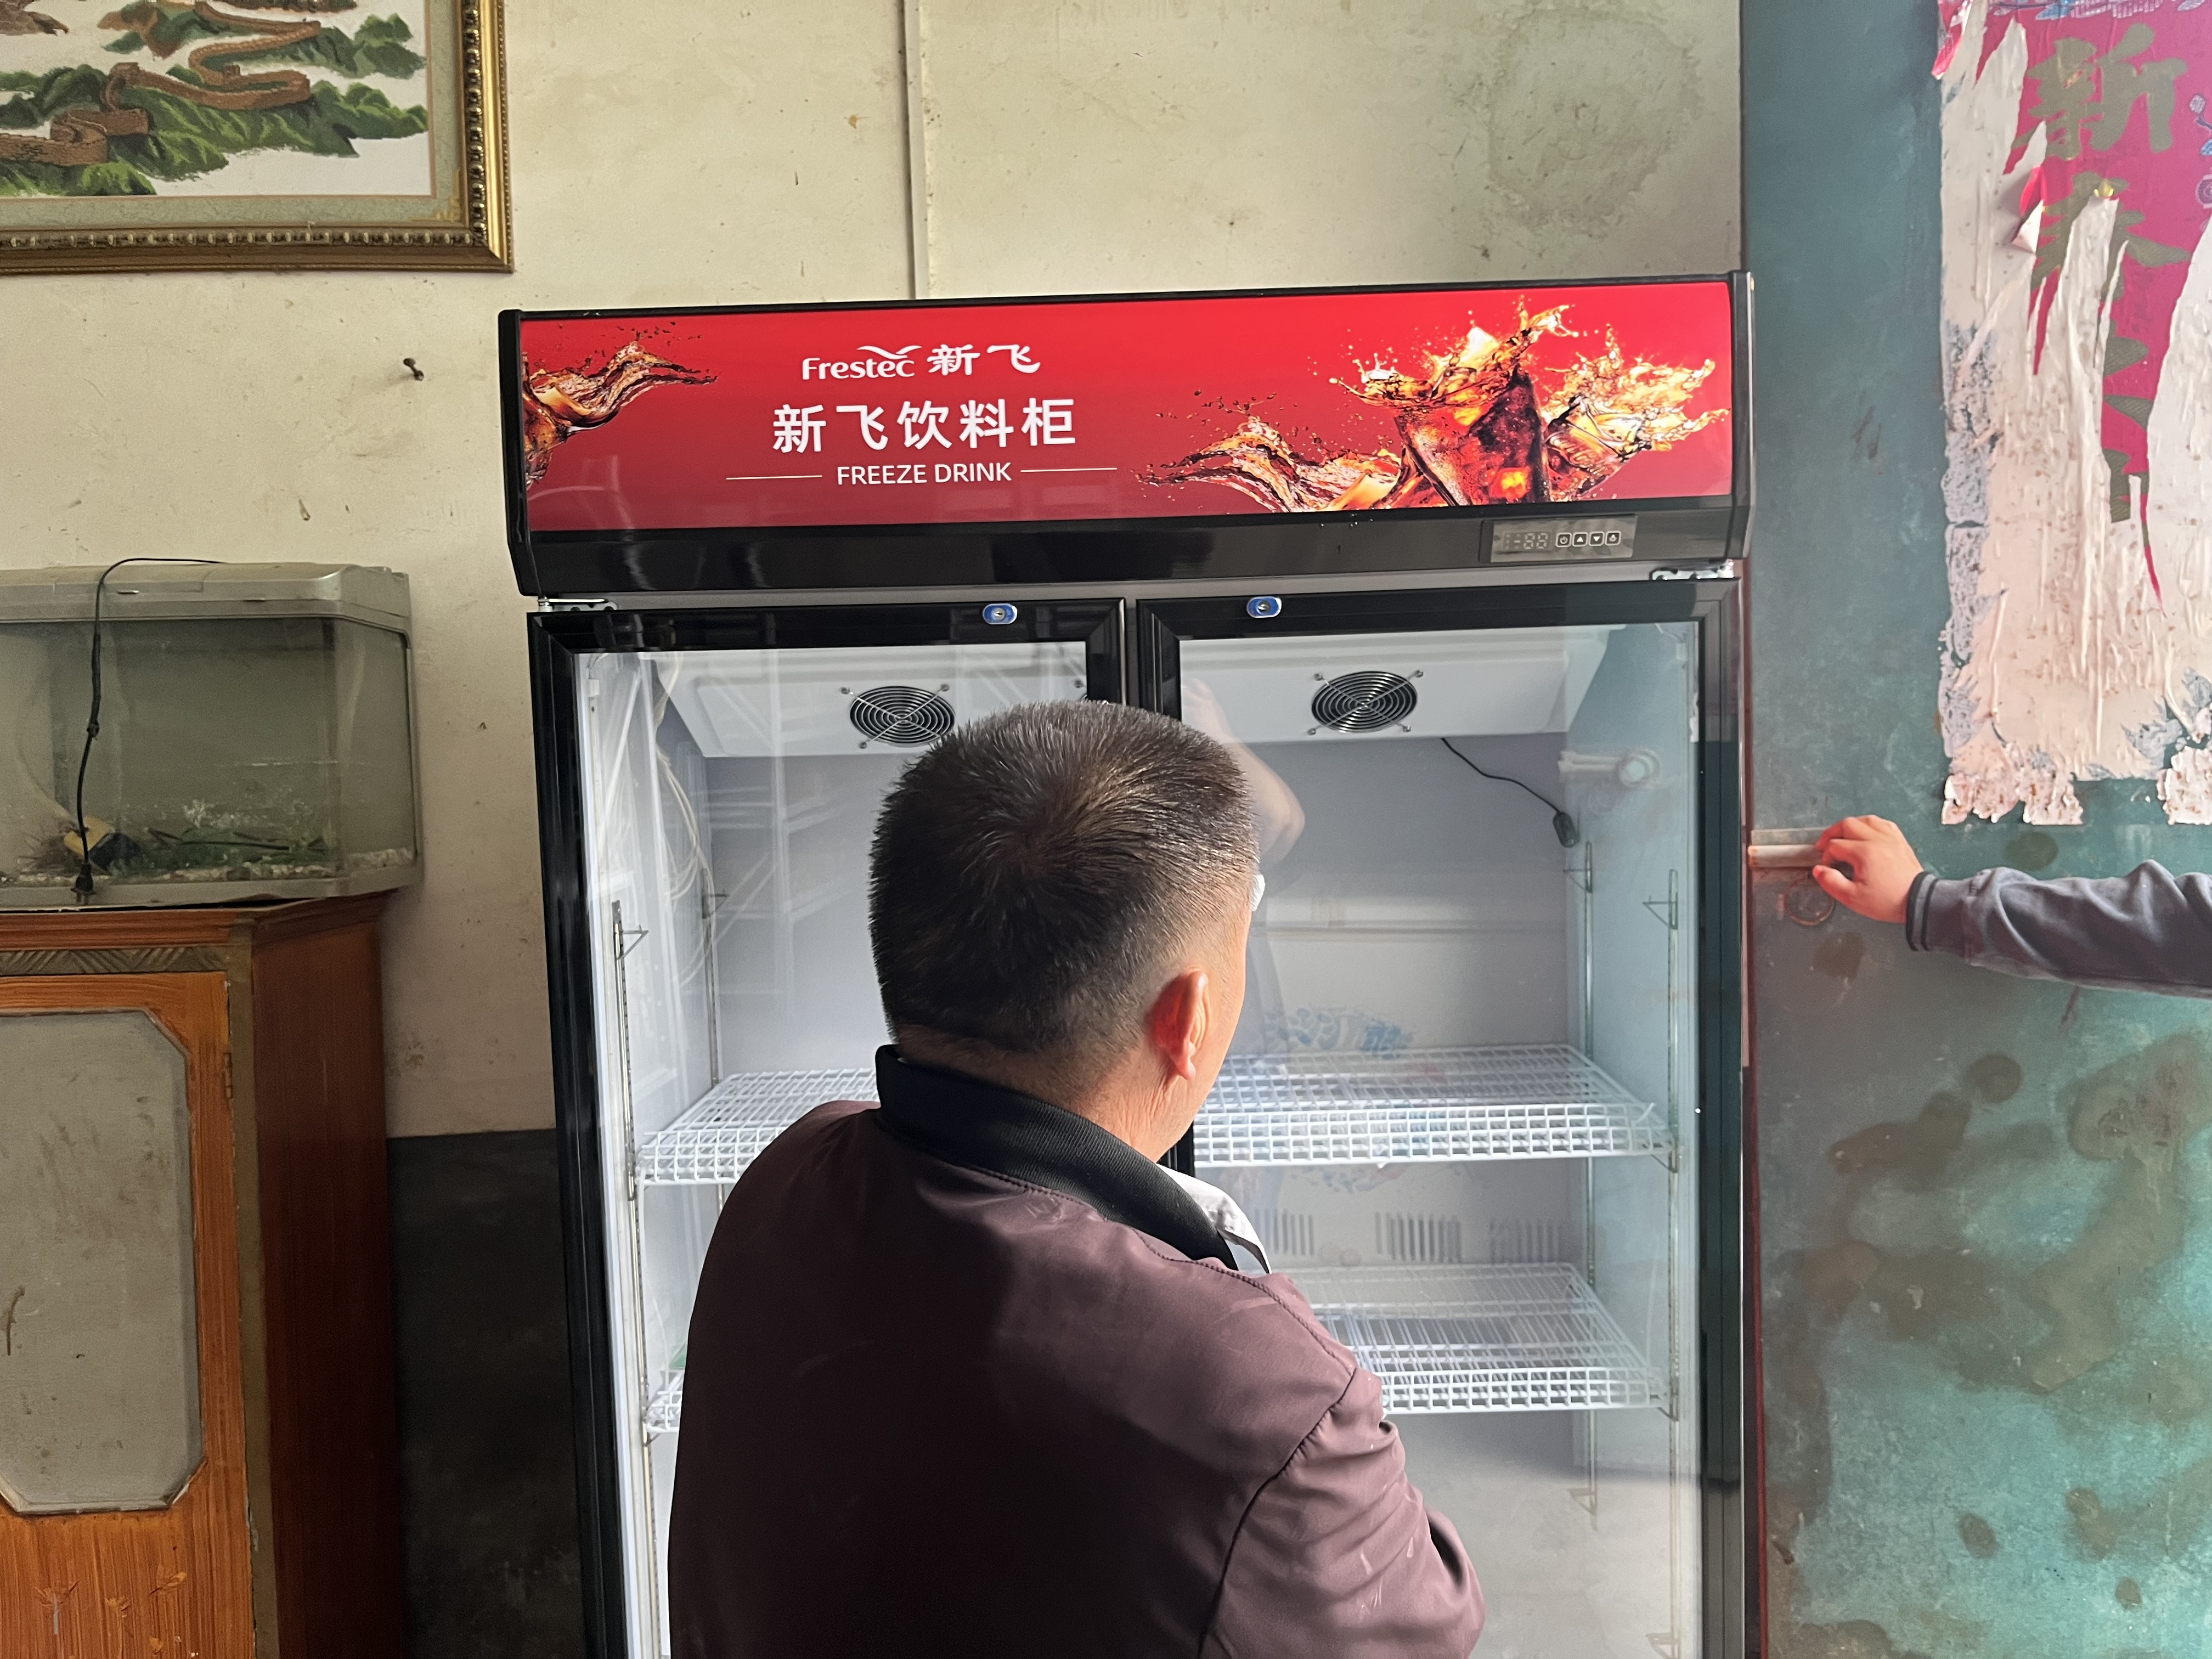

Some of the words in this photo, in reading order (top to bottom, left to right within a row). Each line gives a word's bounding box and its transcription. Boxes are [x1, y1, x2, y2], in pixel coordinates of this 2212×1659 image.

[802, 351, 916, 381] Frestec
[927, 344, 1041, 376] 新飞
[772, 398, 1076, 453] 新飞饮料柜
[837, 464, 928, 486] FREEZE
[934, 462, 1012, 483] DRINK
